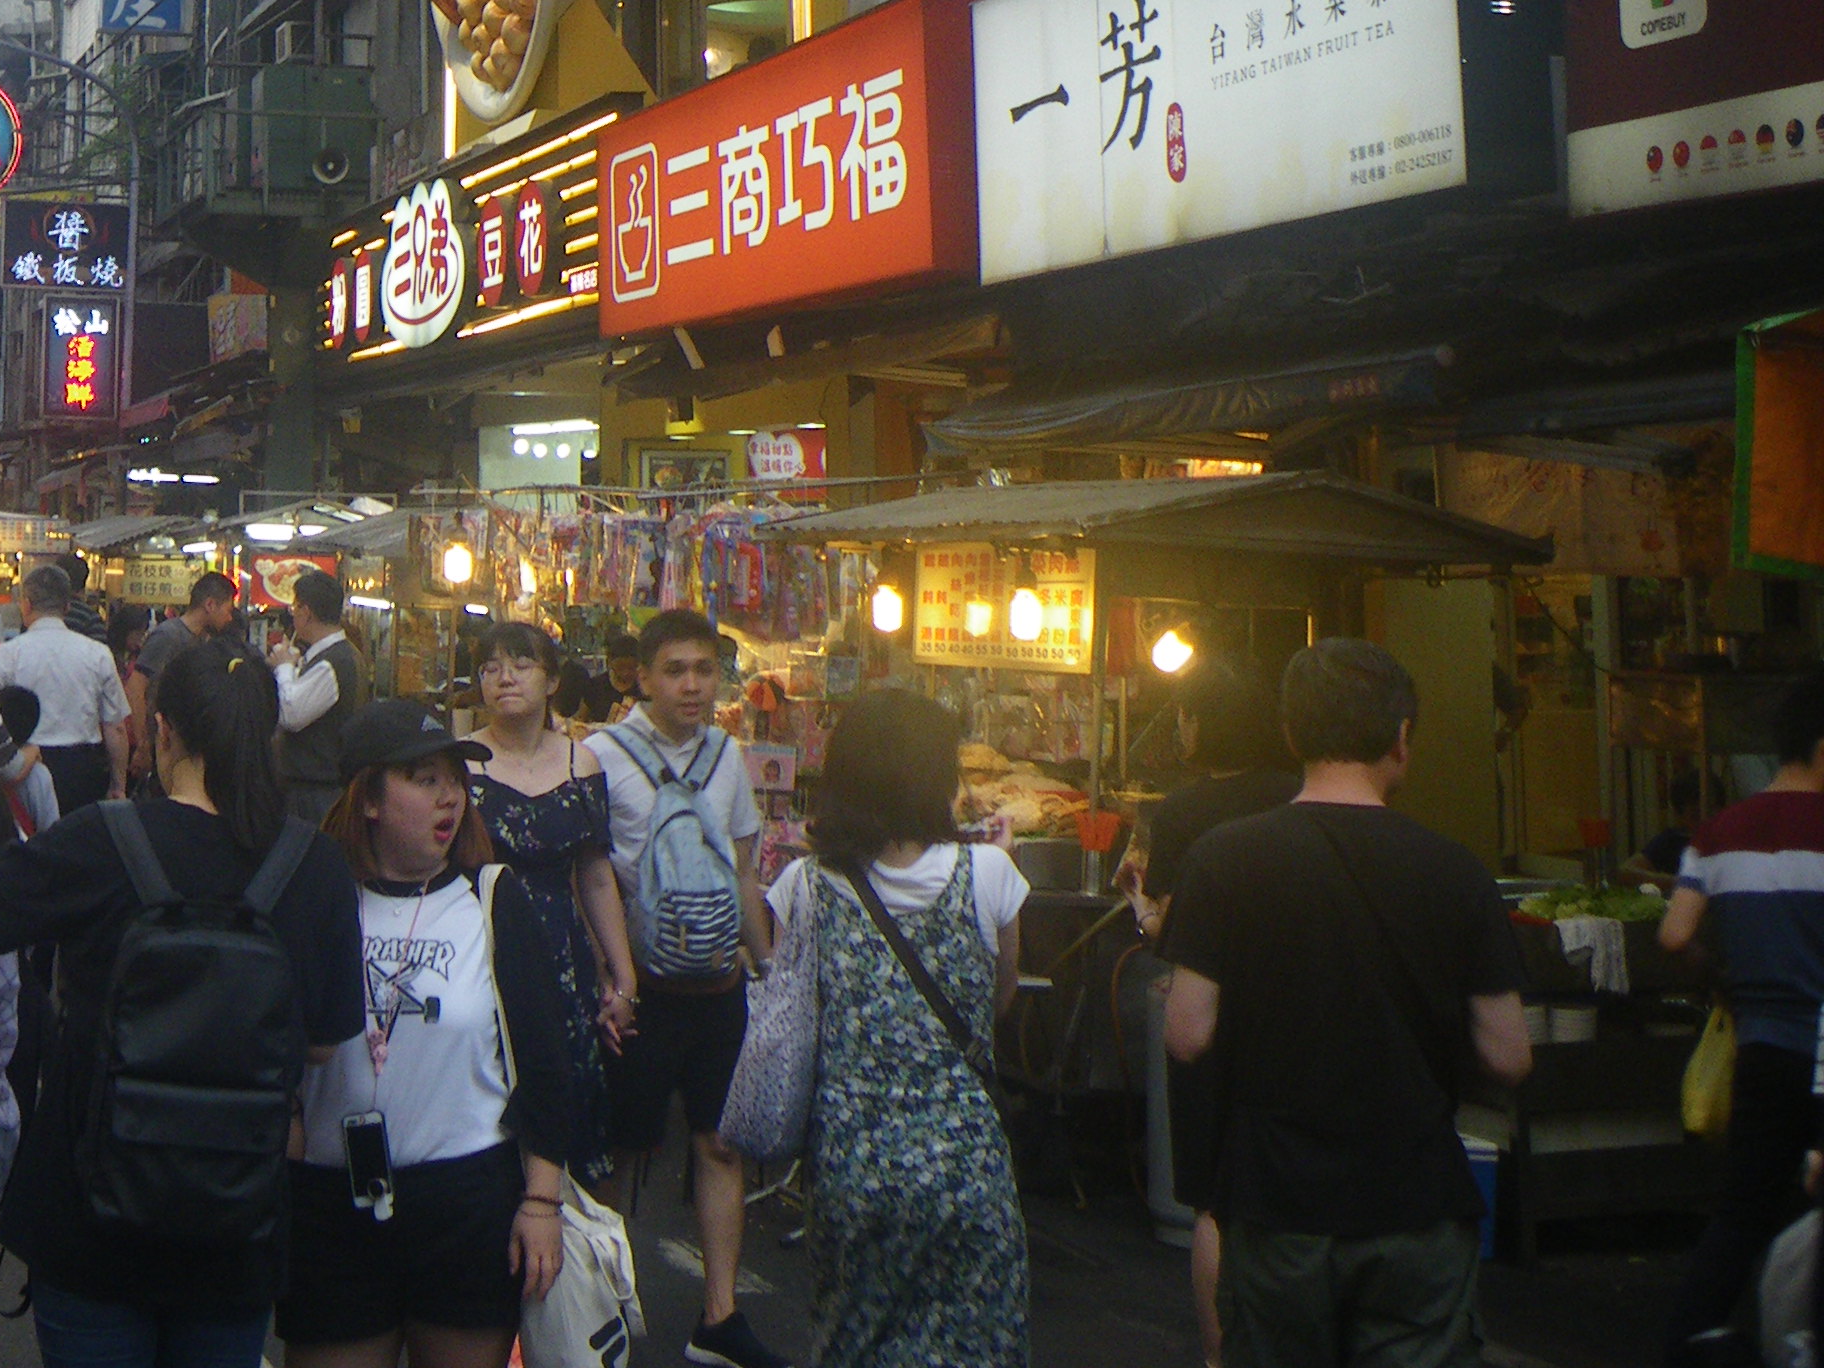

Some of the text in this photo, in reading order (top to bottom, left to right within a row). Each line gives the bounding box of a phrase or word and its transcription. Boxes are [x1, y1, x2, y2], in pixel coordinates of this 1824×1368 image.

[1640, 11, 1687, 36] COMEBUY
[1210, 20, 1394, 90] YIFANG TAIWAN FRUIT TEA
[665, 67, 910, 267] 三商巧福
[1168, 111, 1185, 173] 陳家
[48, 211, 89, 251] 醬
[394, 198, 448, 305] 三兄弟
[482, 197, 542, 289] 豆花
[11, 252, 123, 287] 鐵板燒
[53, 307, 109, 336] 松山
[65, 335, 96, 411] 活海鮮
[362, 938, 454, 980] RASHER
